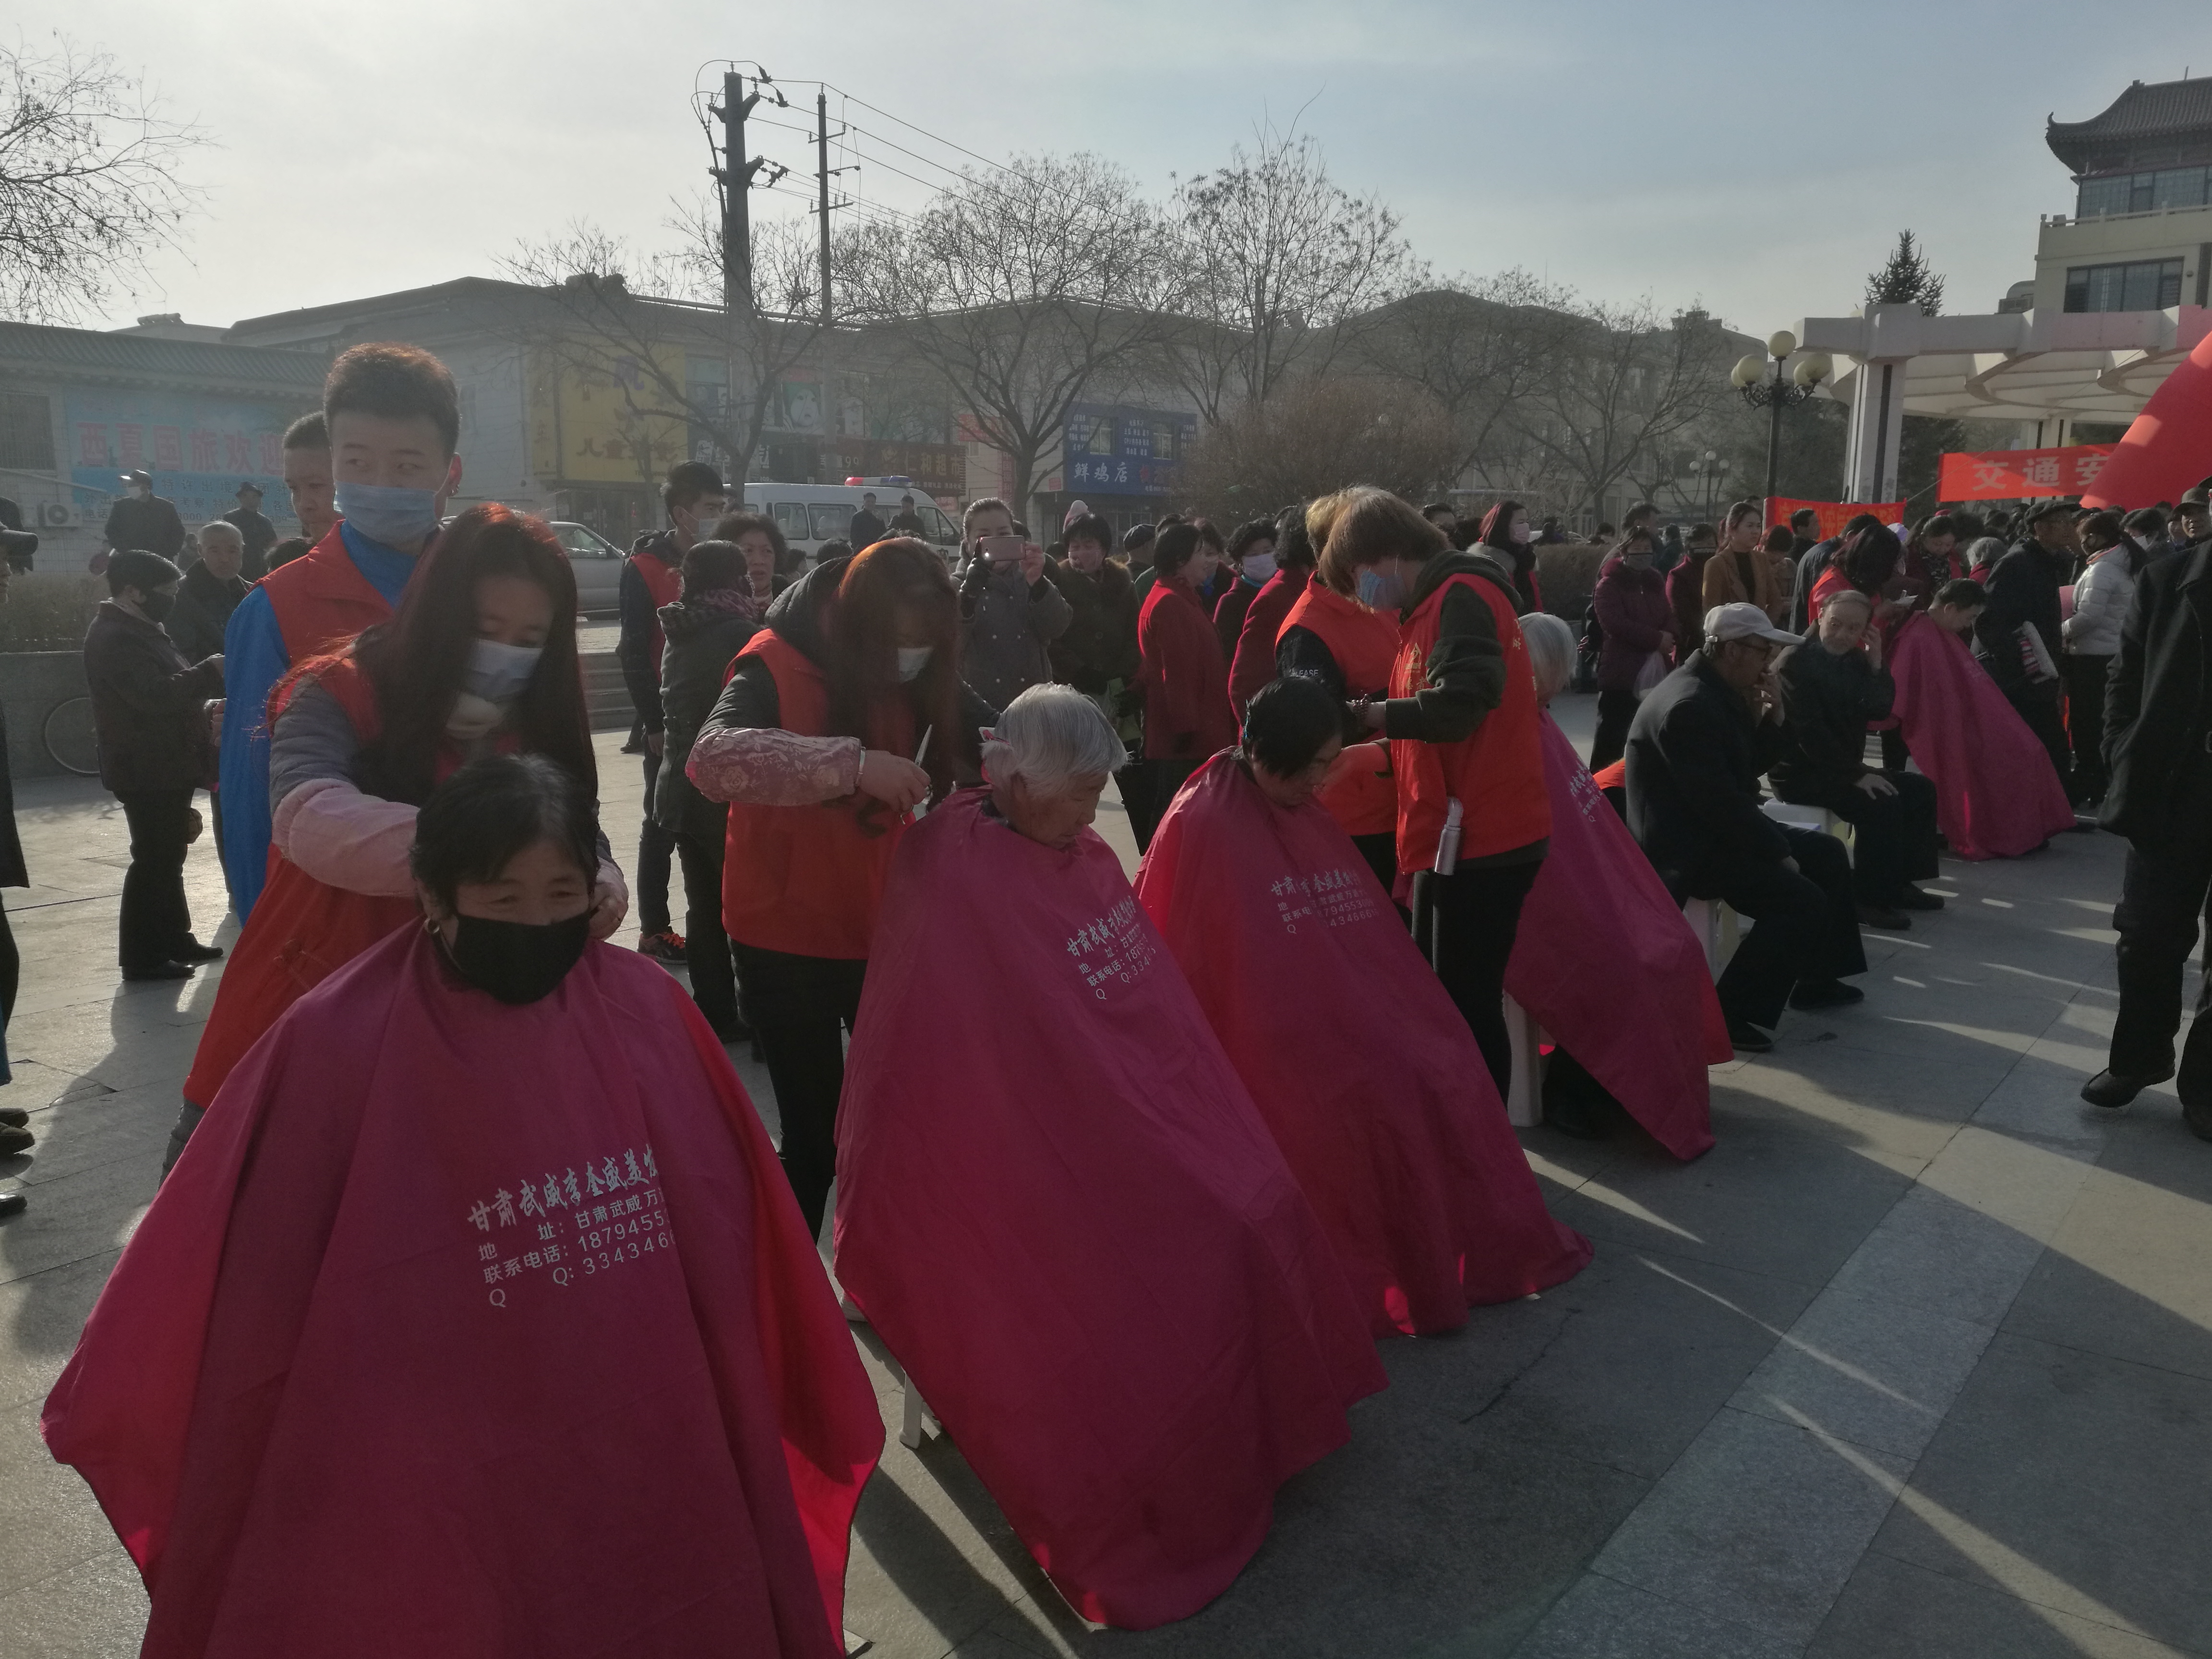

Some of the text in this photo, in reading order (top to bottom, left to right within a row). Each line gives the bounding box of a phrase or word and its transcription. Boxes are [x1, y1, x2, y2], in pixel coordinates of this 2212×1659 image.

[1073, 461, 1128, 483] 鲜鸡店
[1277, 901, 1289, 912] 地
[1079, 962, 1091, 974] 地
[478, 1242, 498, 1262] 地
